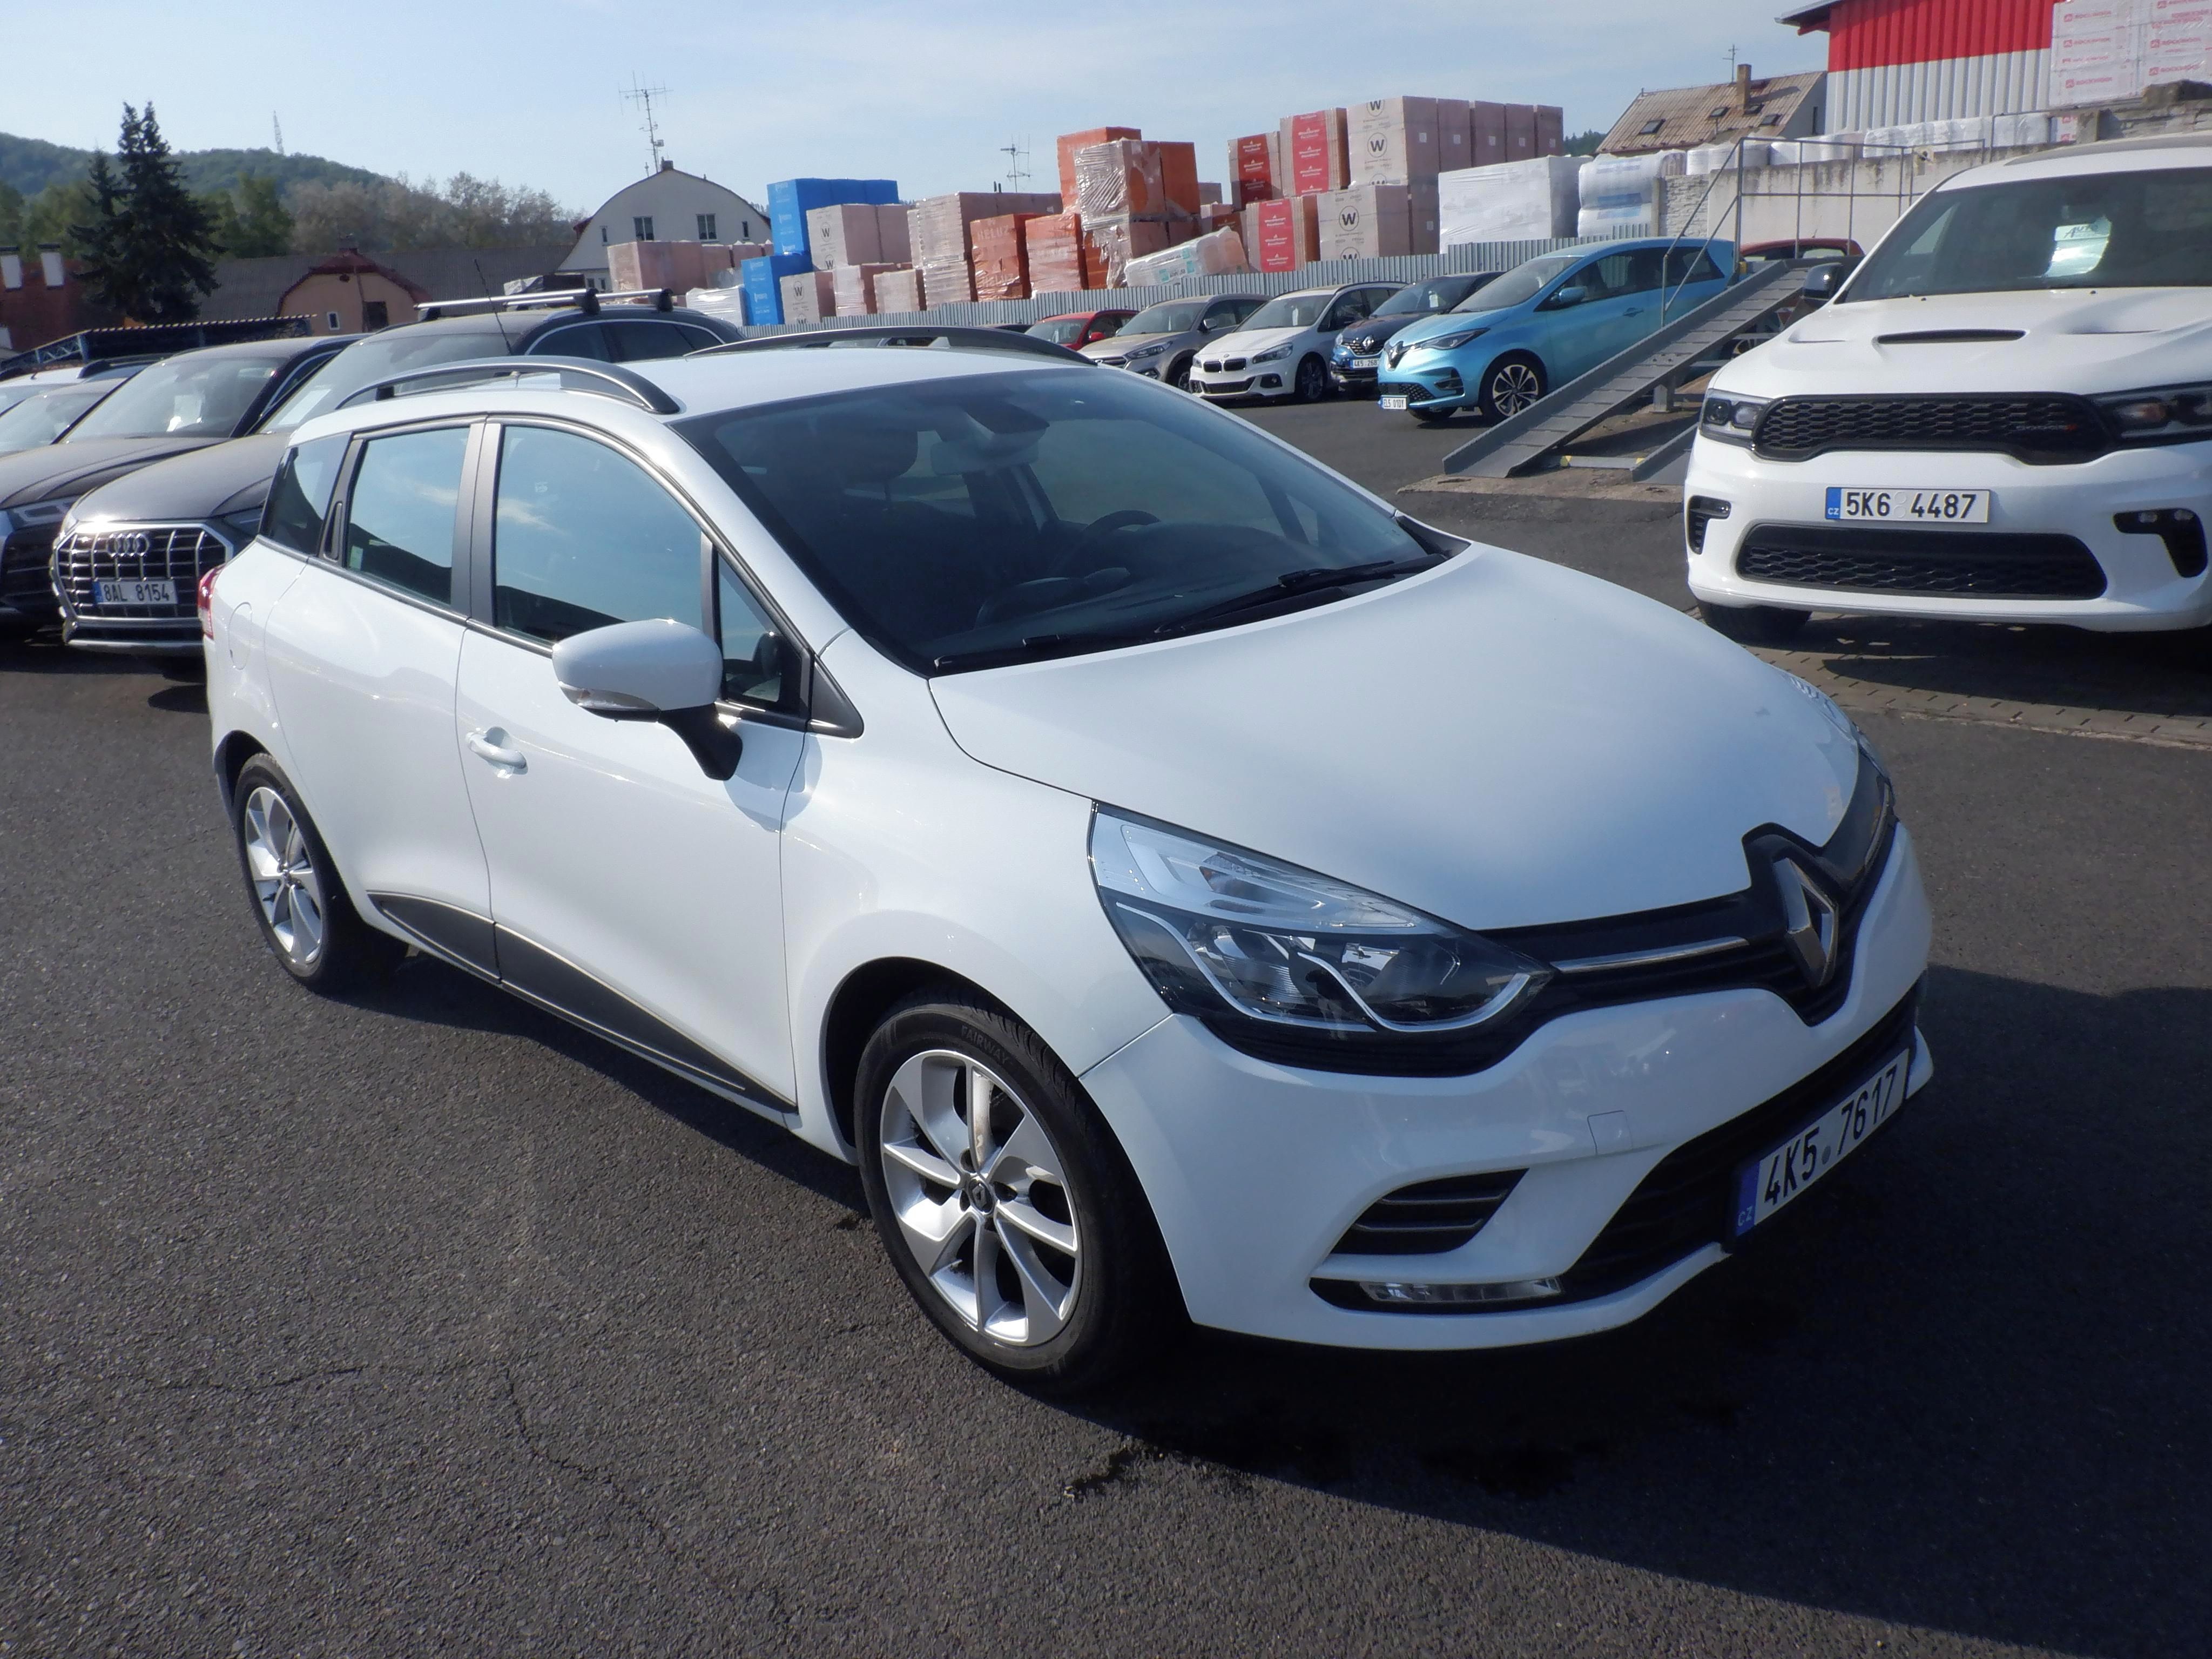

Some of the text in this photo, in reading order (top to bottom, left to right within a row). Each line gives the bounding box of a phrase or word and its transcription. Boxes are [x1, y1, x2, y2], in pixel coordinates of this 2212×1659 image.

[1370, 100, 1381, 111] W
[1371, 139, 1385, 152] W
[1342, 212, 1356, 226] W
[821, 227, 830, 238] W
[977, 225, 1009, 239] HELUZ
[825, 260, 833, 270] W
[794, 287, 802, 297] W
[1846, 492, 1891, 516] 5K6
[1911, 493, 1977, 518] 4487
[104, 584, 170, 602] 8AL 8154
[961, 1025, 1009, 1064] FAIRWAY
[1737, 1064, 1897, 1227] CZ 4K5 7617
